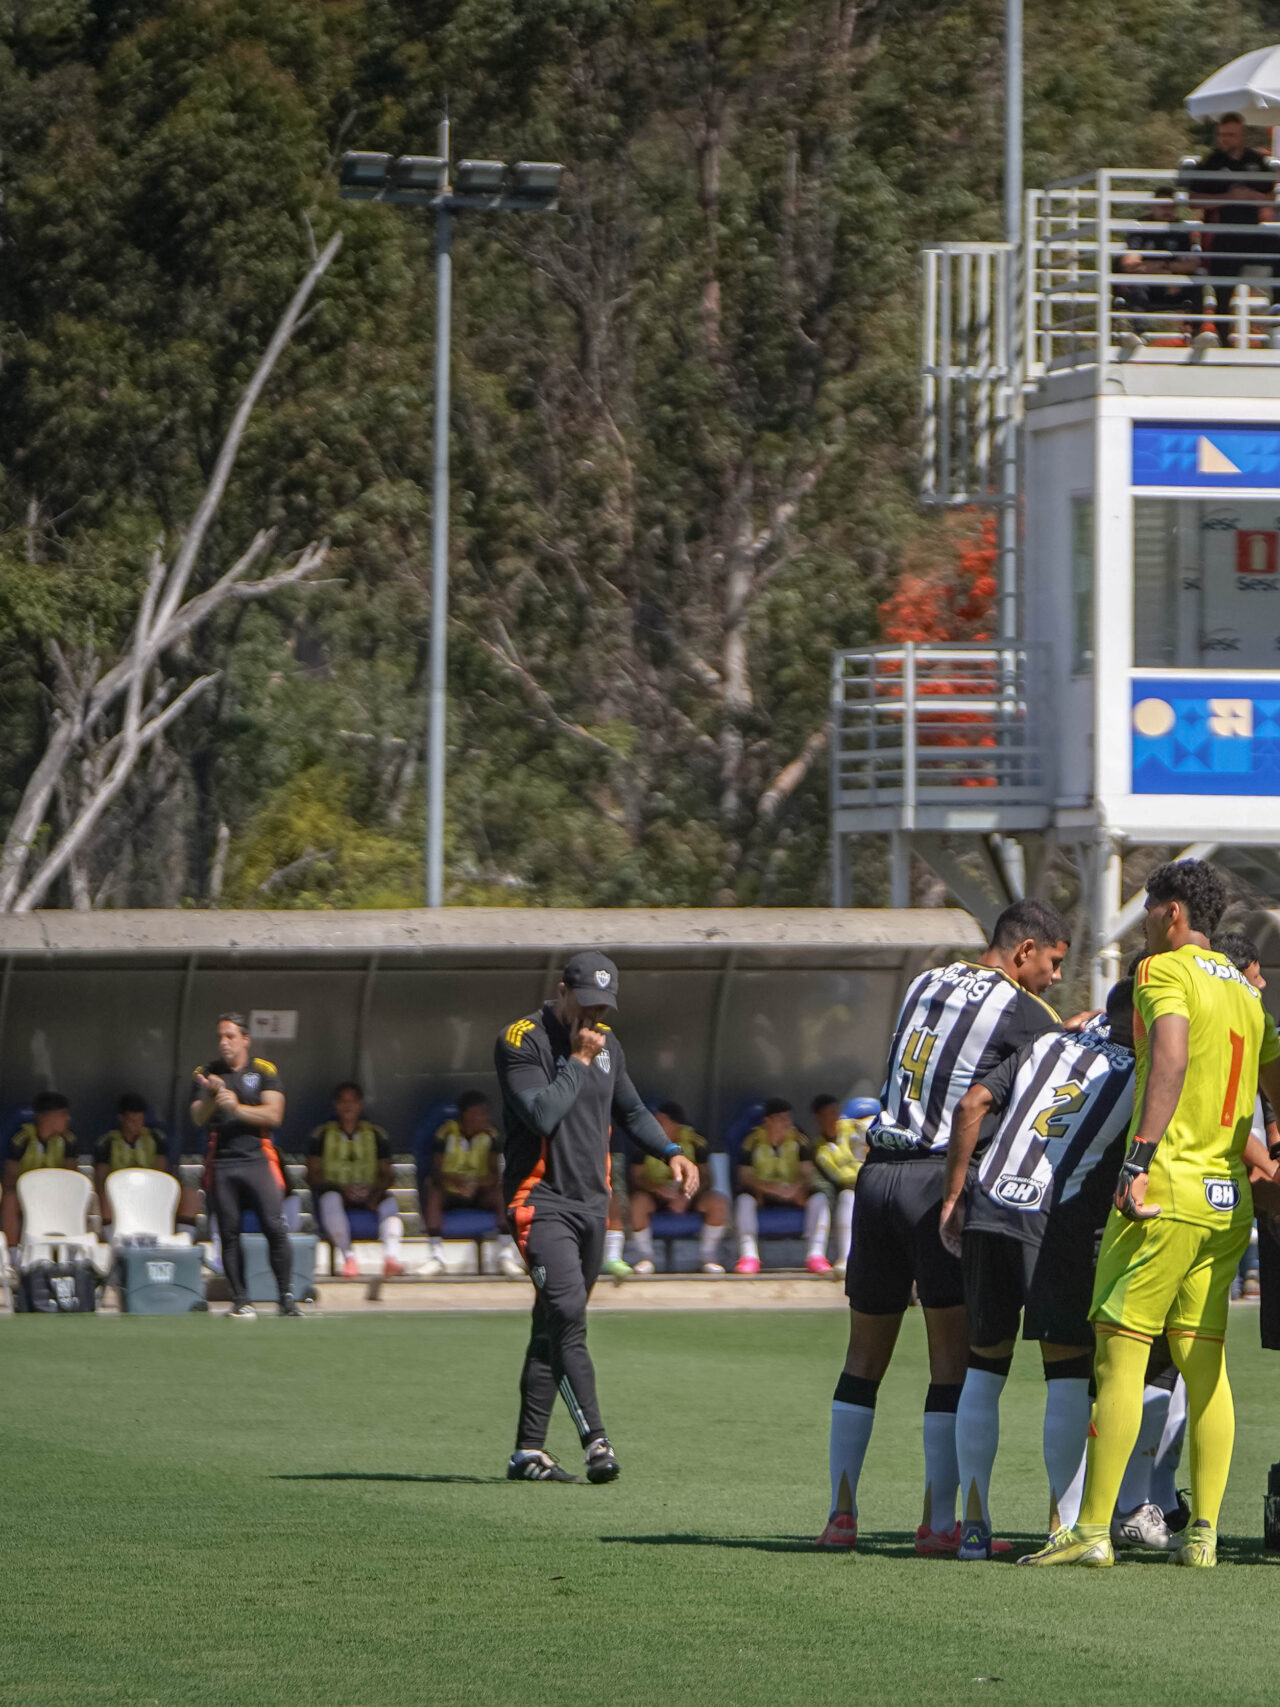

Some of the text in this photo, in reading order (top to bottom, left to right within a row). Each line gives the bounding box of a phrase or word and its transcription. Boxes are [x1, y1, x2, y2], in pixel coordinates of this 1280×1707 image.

[1236, 575, 1280, 592] Sesc
[939, 966, 993, 1003] bmg
[899, 1028, 938, 1101] 4
[1078, 1031, 1136, 1072] bmg
[1101, 1040, 1130, 1056] banco
[1220, 1027, 1245, 1128] 1
[1029, 1080, 1089, 1139] 2
[1000, 1181, 1035, 1202] BH
[1211, 1184, 1235, 1205] BH
